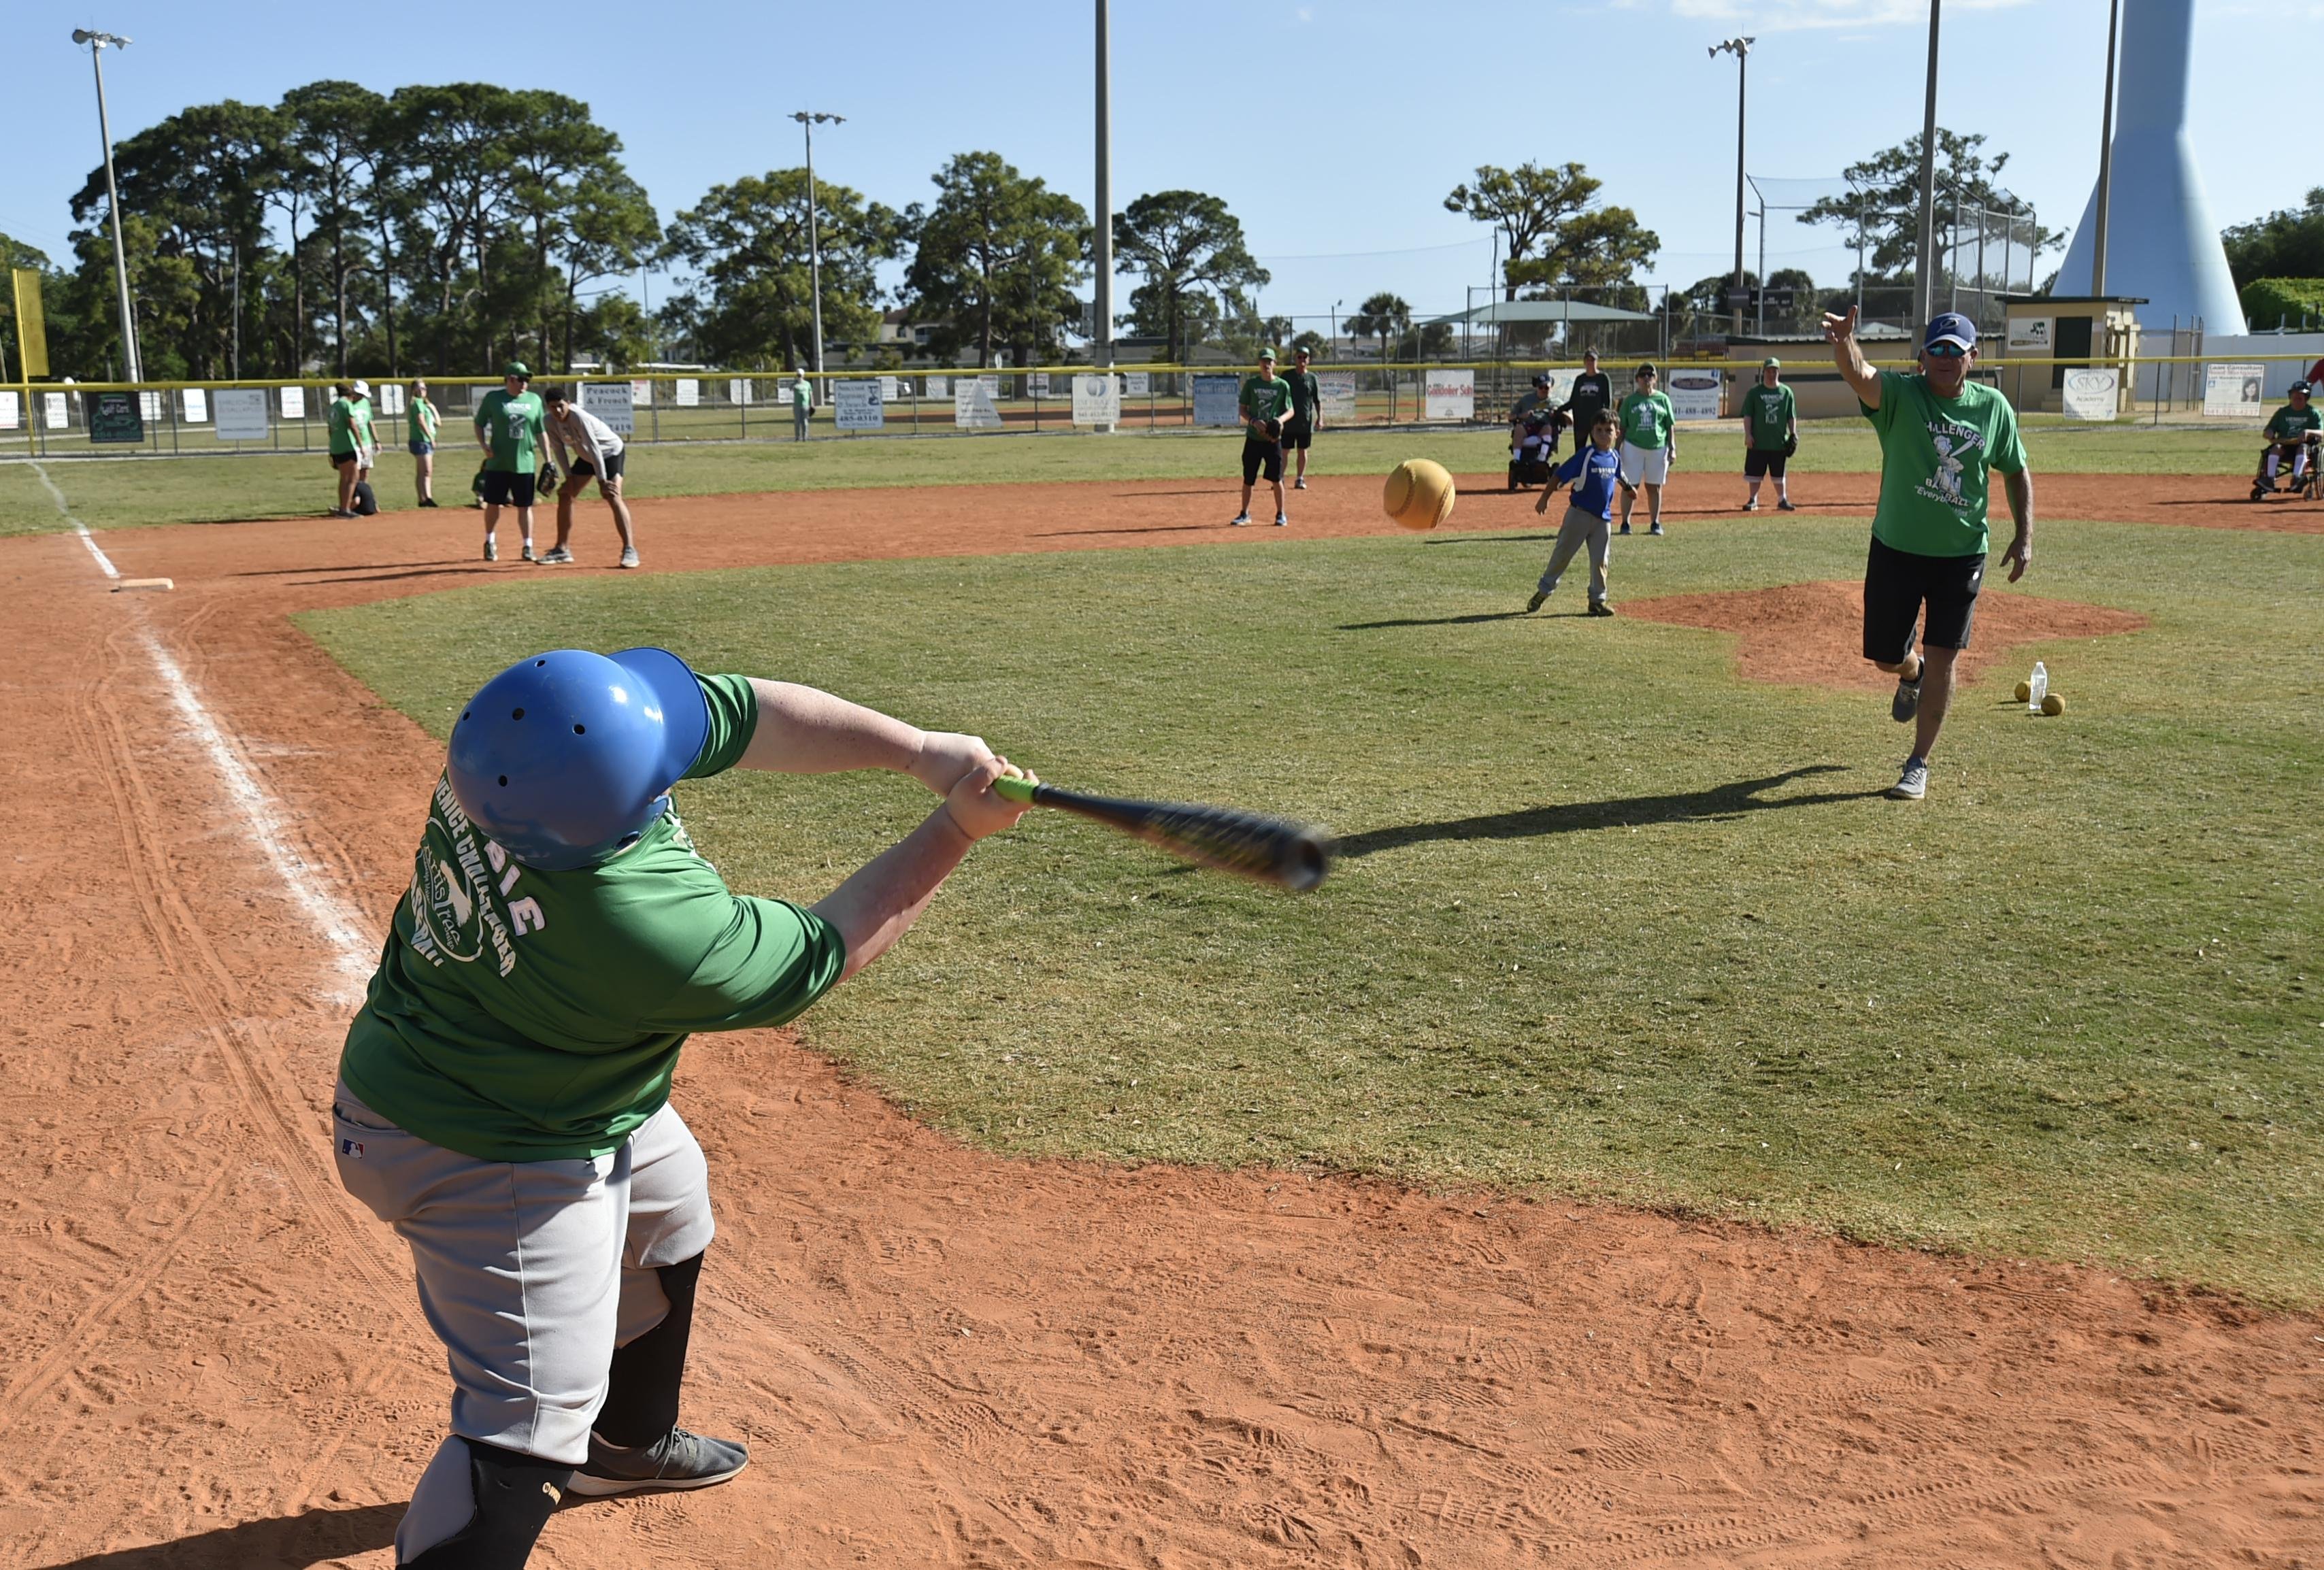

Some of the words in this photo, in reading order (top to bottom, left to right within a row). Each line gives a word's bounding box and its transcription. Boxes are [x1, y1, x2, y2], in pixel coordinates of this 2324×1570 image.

[2076, 375, 2106, 392] SKY
[586, 386, 627, 395] Peacock
[1254, 388, 1278, 396] VENICE
[1427, 384, 1459, 397] Gondolier
[1674, 407, 1716, 415] 41-488-4892
[456, 833, 516, 978] CHALLENGER
